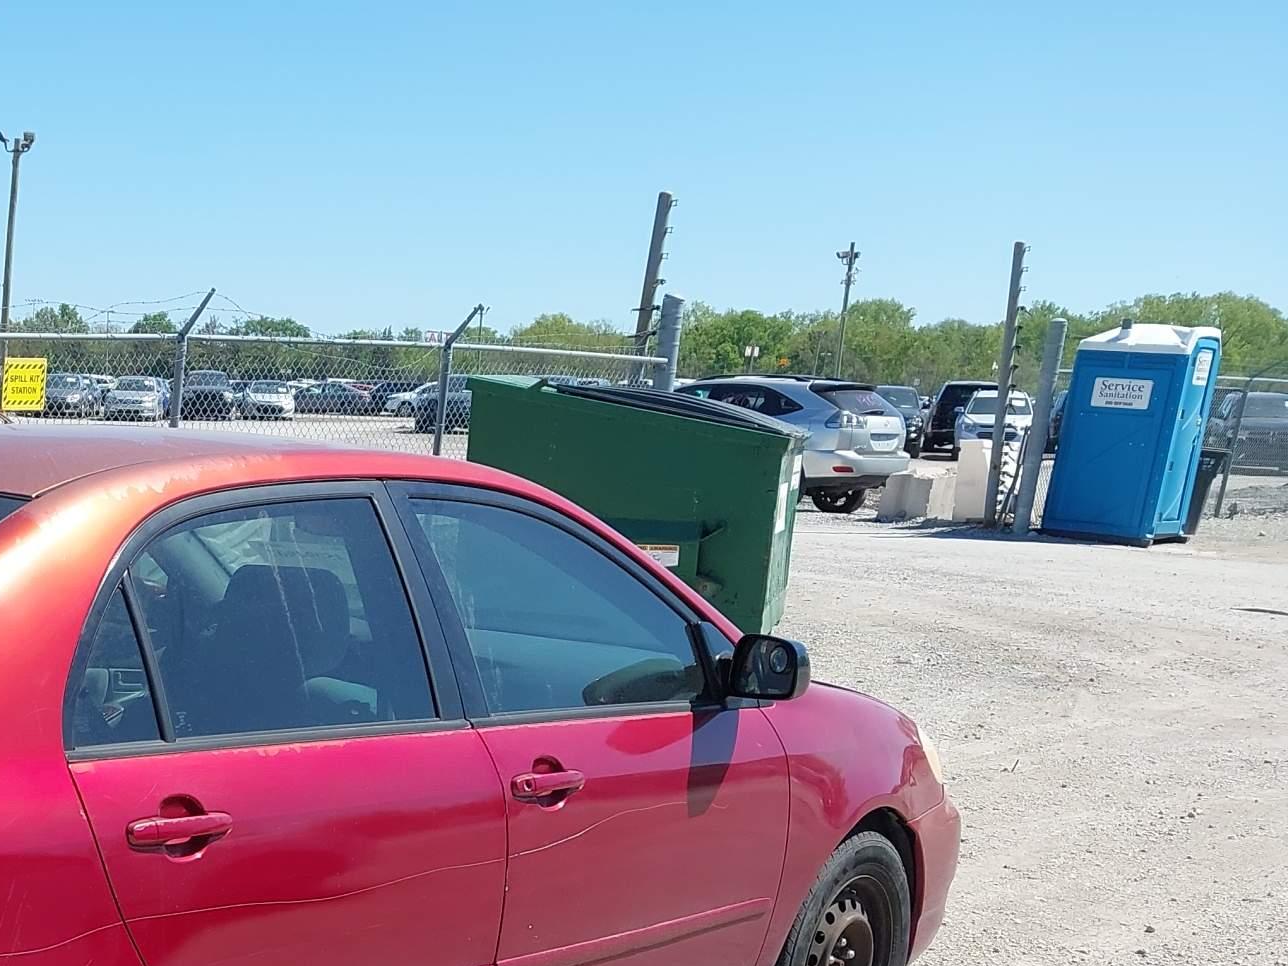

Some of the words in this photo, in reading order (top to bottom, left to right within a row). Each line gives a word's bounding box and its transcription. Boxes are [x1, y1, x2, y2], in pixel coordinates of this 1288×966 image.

[10, 375, 28, 383] SPILL
[30, 375, 40, 383] KIT
[11, 386, 37, 394] STATION
[1100, 379, 1145, 393] Service
[1098, 390, 1143, 400] Sanitation
